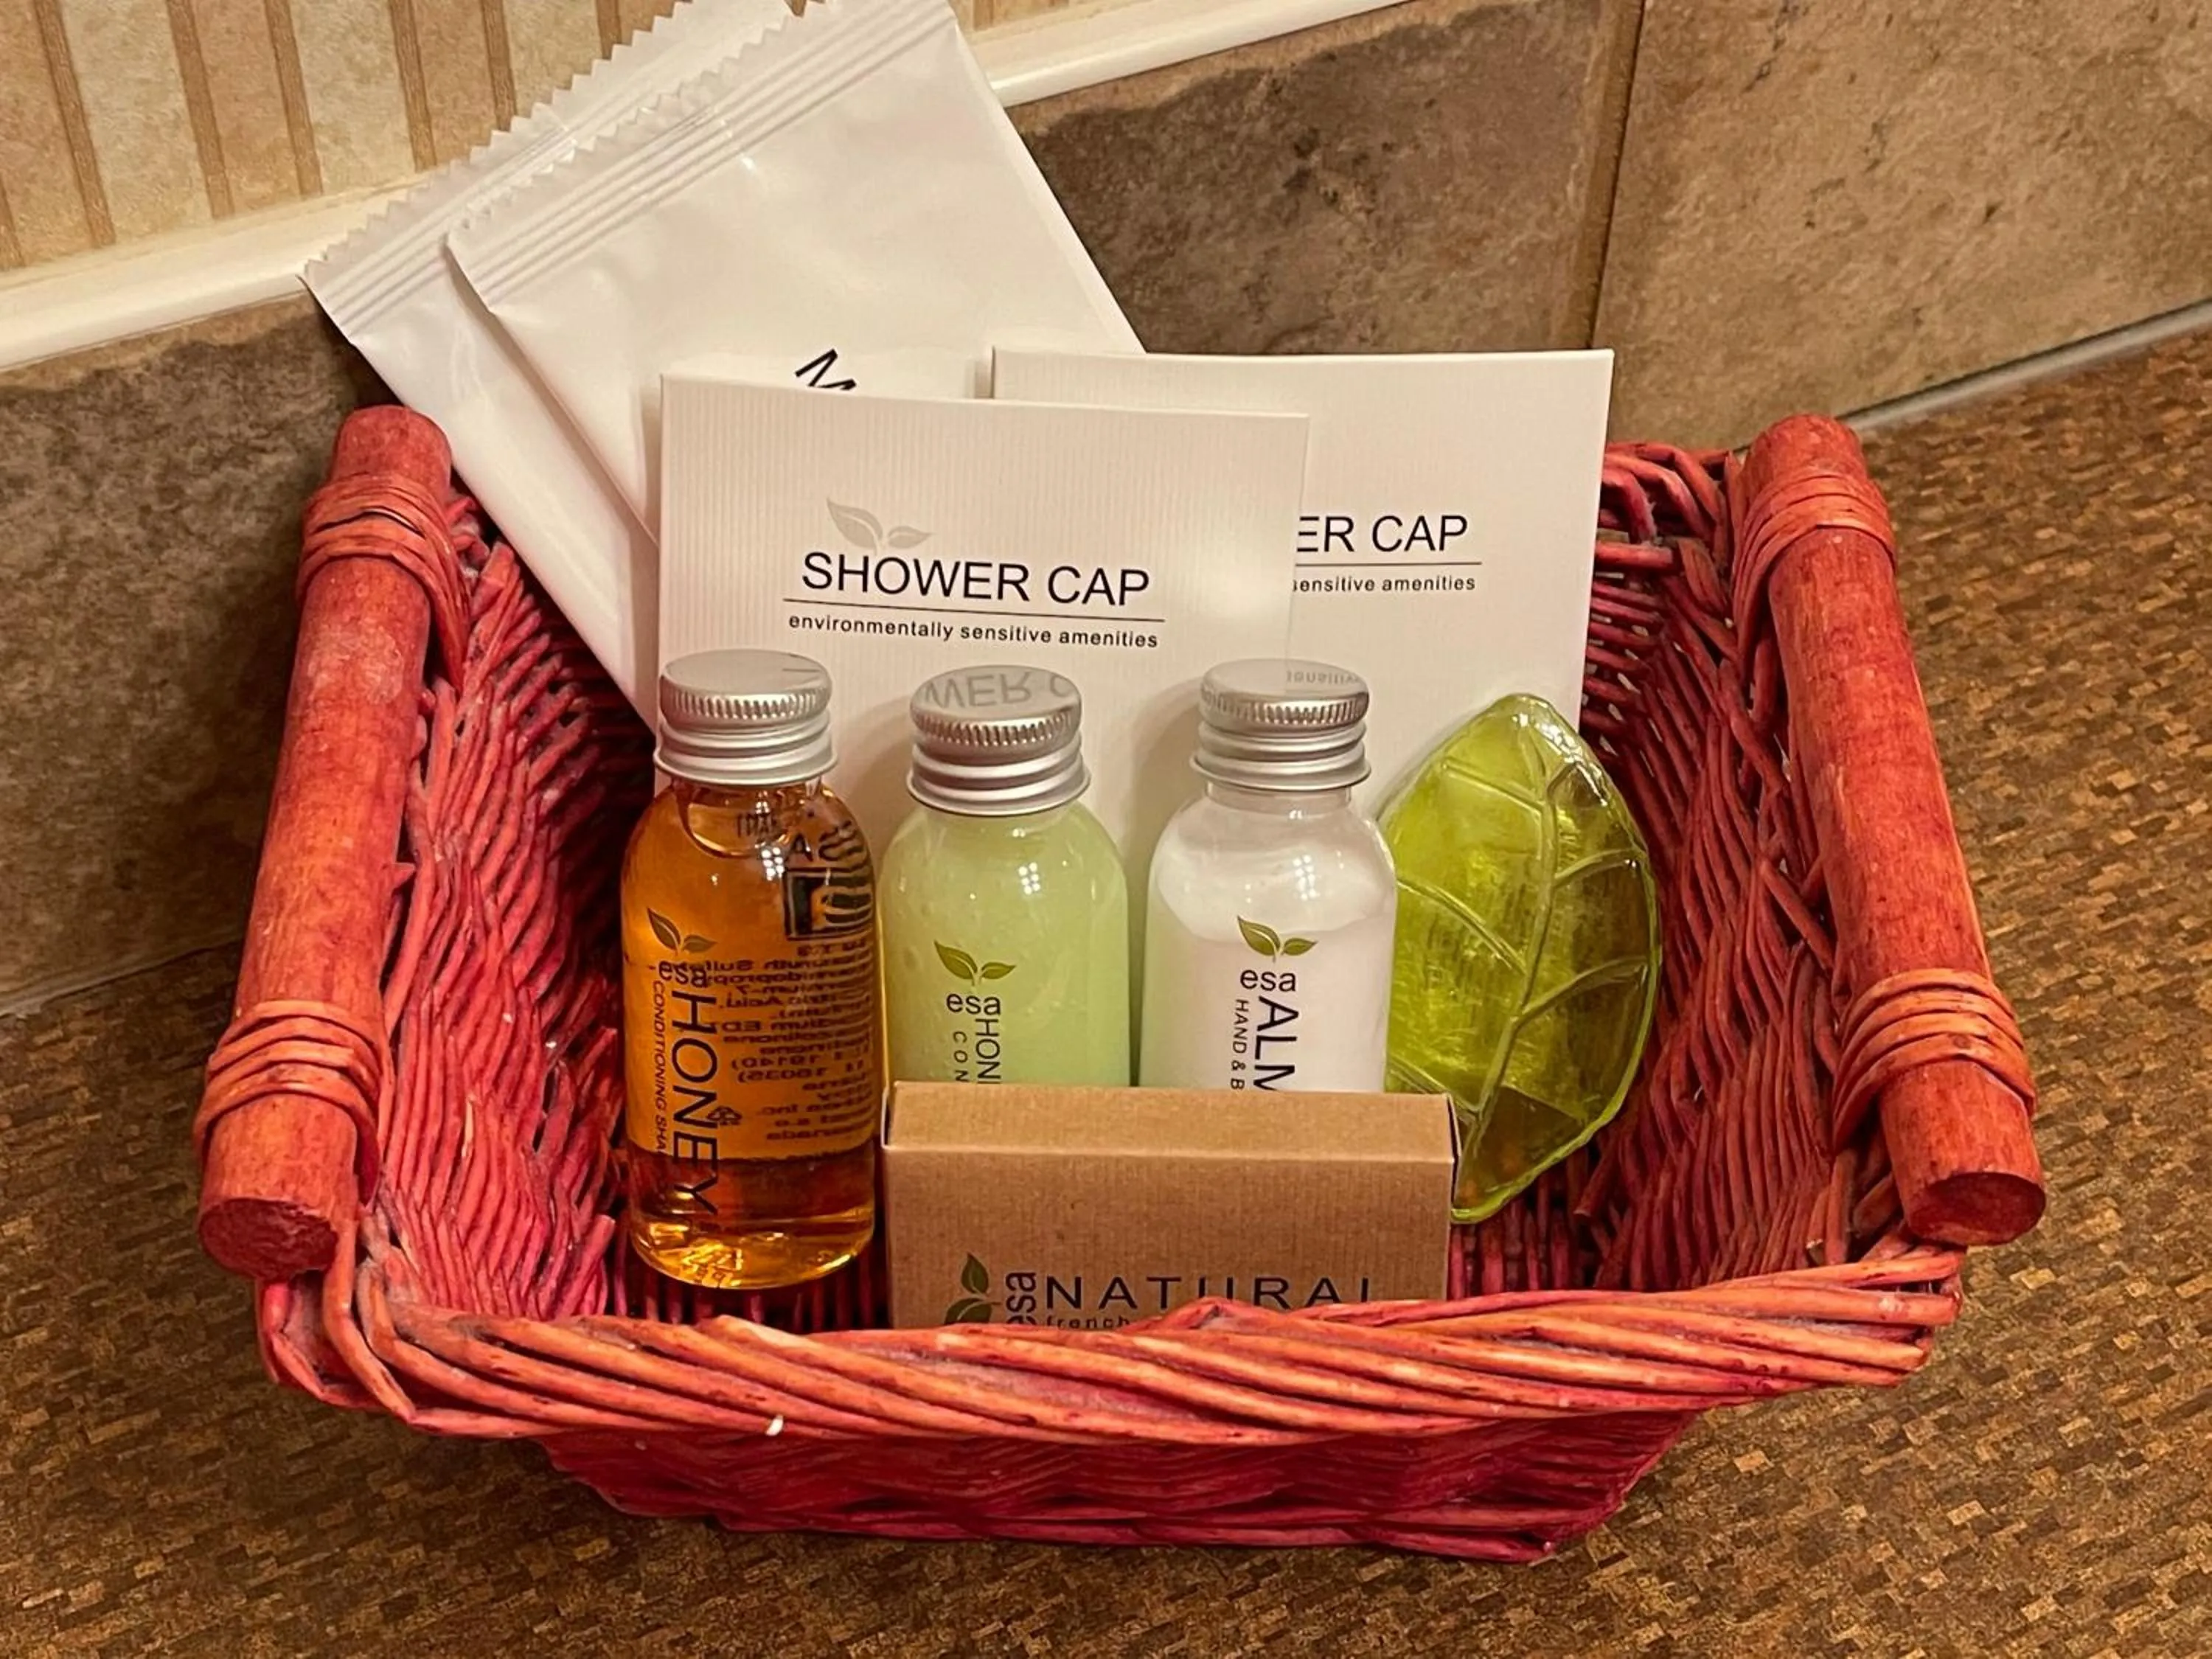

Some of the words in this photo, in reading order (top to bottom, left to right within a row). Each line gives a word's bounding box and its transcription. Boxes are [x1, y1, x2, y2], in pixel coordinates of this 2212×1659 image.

[1372, 515, 1468, 552] CAP
[801, 551, 1030, 602] SHOWER
[1047, 565, 1150, 607] CAP
[1382, 574, 1476, 591] amenities
[788, 613, 954, 641] environmentally
[960, 624, 1051, 644] sensitive
[1059, 629, 1158, 648] amenities
[658, 960, 709, 988] esa
[1239, 969, 1296, 992] esa
[946, 993, 1001, 1015] esa
[1233, 999, 1249, 1054] HAND
[653, 980, 667, 1113] CONDITIONING
[975, 1018, 1001, 1084] HON
[1231, 1060, 1246, 1071] &
[671, 990, 717, 1215] HONEY
[655, 1114, 667, 1151] SHA
